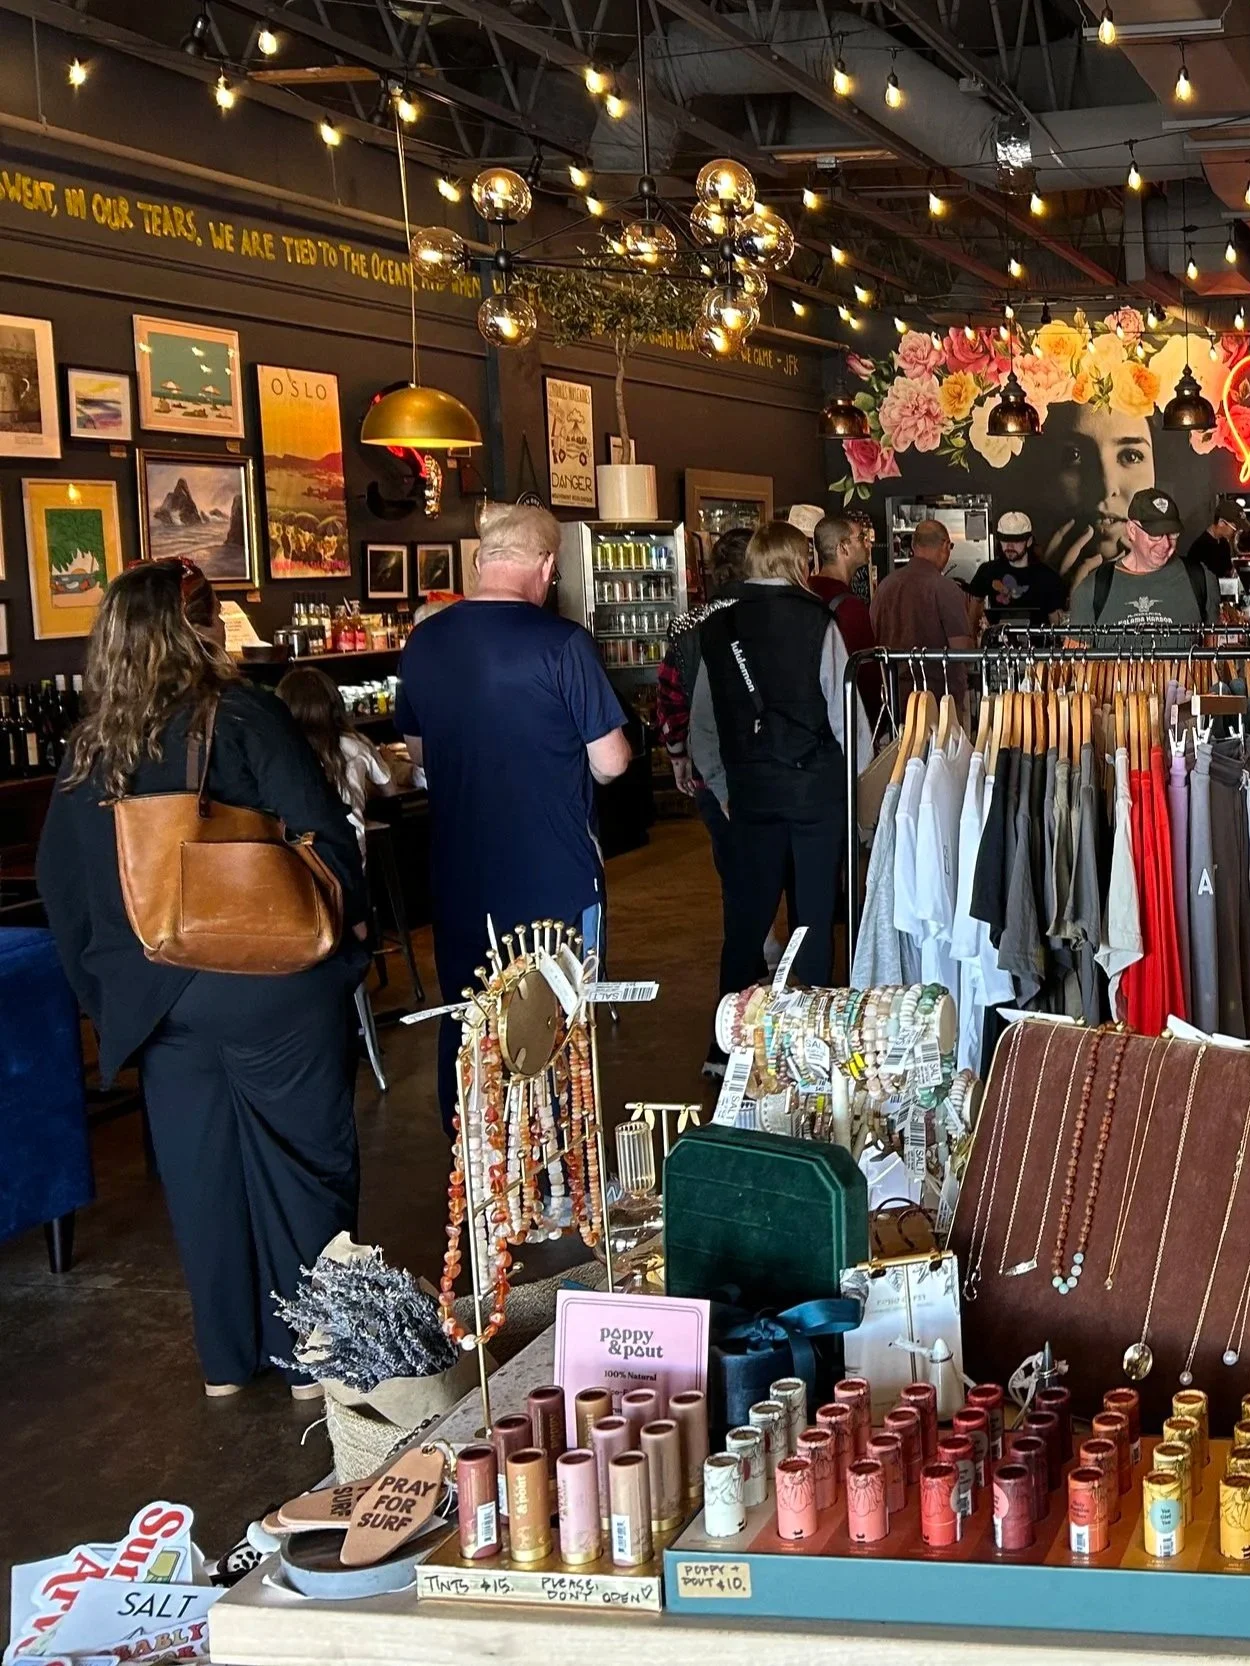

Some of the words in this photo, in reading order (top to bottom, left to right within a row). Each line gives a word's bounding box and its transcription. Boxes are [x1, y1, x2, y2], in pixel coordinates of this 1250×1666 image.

[64, 188, 87, 220] IN
[92, 193, 134, 231] OUR
[137, 201, 203, 247] TEARS.
[208, 222, 235, 253] WE
[241, 229, 276, 260] ARE
[282, 235, 319, 266] TIED
[318, 240, 338, 267] TO
[339, 244, 369, 279] THE
[784, 354, 799, 376] JFK
[271, 378, 327, 400] OSLO
[551, 472, 592, 492] DANGER
[730, 640, 755, 693] lululemon
[1198, 869, 1214, 895] A
[928, 1063, 942, 1082] SALT
[726, 1095, 741, 1121] SALT
[915, 1150, 925, 1175] SALT
[600, 1327, 654, 1344] poppy
[604, 1370, 627, 1380] 100%
[627, 1371, 657, 1381] Natural
[378, 1476, 436, 1497] PRAY
[330, 1487, 352, 1516] SURF
[373, 1495, 416, 1514] FOR
[357, 1513, 413, 1532] SURF
[684, 1565, 725, 1576] POPPY
[424, 1576, 470, 1594] TINTS
[118, 1592, 198, 1618] SALT
[602, 1592, 641, 1603] OPEN
